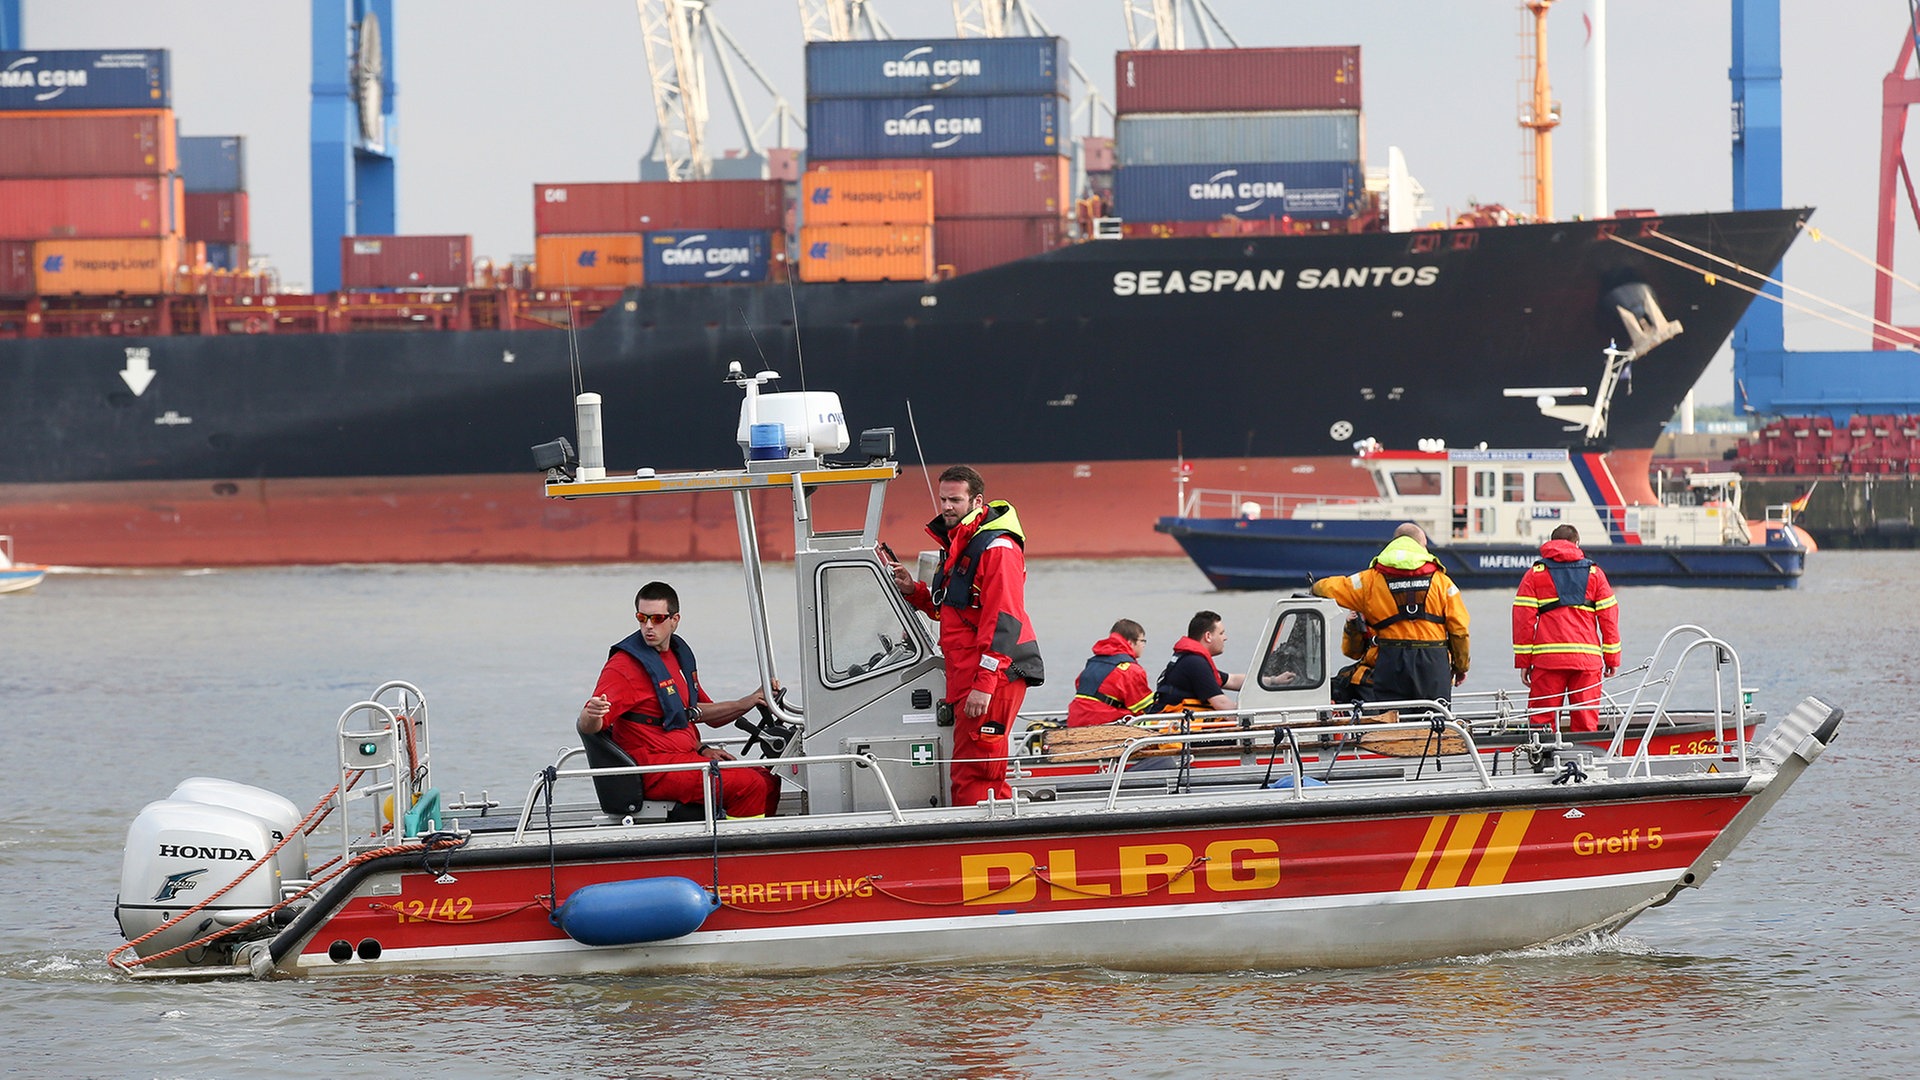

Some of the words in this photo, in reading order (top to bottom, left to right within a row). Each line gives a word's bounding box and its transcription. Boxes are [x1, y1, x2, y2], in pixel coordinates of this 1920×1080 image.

[883, 61, 931, 77] CMA
[933, 59, 981, 76] CGM
[37, 69, 87, 87] CGM
[884, 119, 933, 135] CMA
[934, 118, 982, 135] CGM
[842, 189, 922, 202] Hapag-Lloyd
[1189, 183, 1235, 200] CMA
[1238, 182, 1285, 199] CGM
[73, 257, 157, 271] Hapag-Lloyd
[662, 248, 704, 265] CMA
[706, 247, 750, 264] CGM
[1113, 269, 1285, 295] SEASPAN
[1296, 266, 1440, 289] SANTOS
[1573, 828, 1640, 856] Greif
[1647, 826, 1664, 849] 5
[159, 844, 256, 861] HONDA
[961, 838, 1281, 906] DLRG
[393, 896, 474, 923] 12/42
